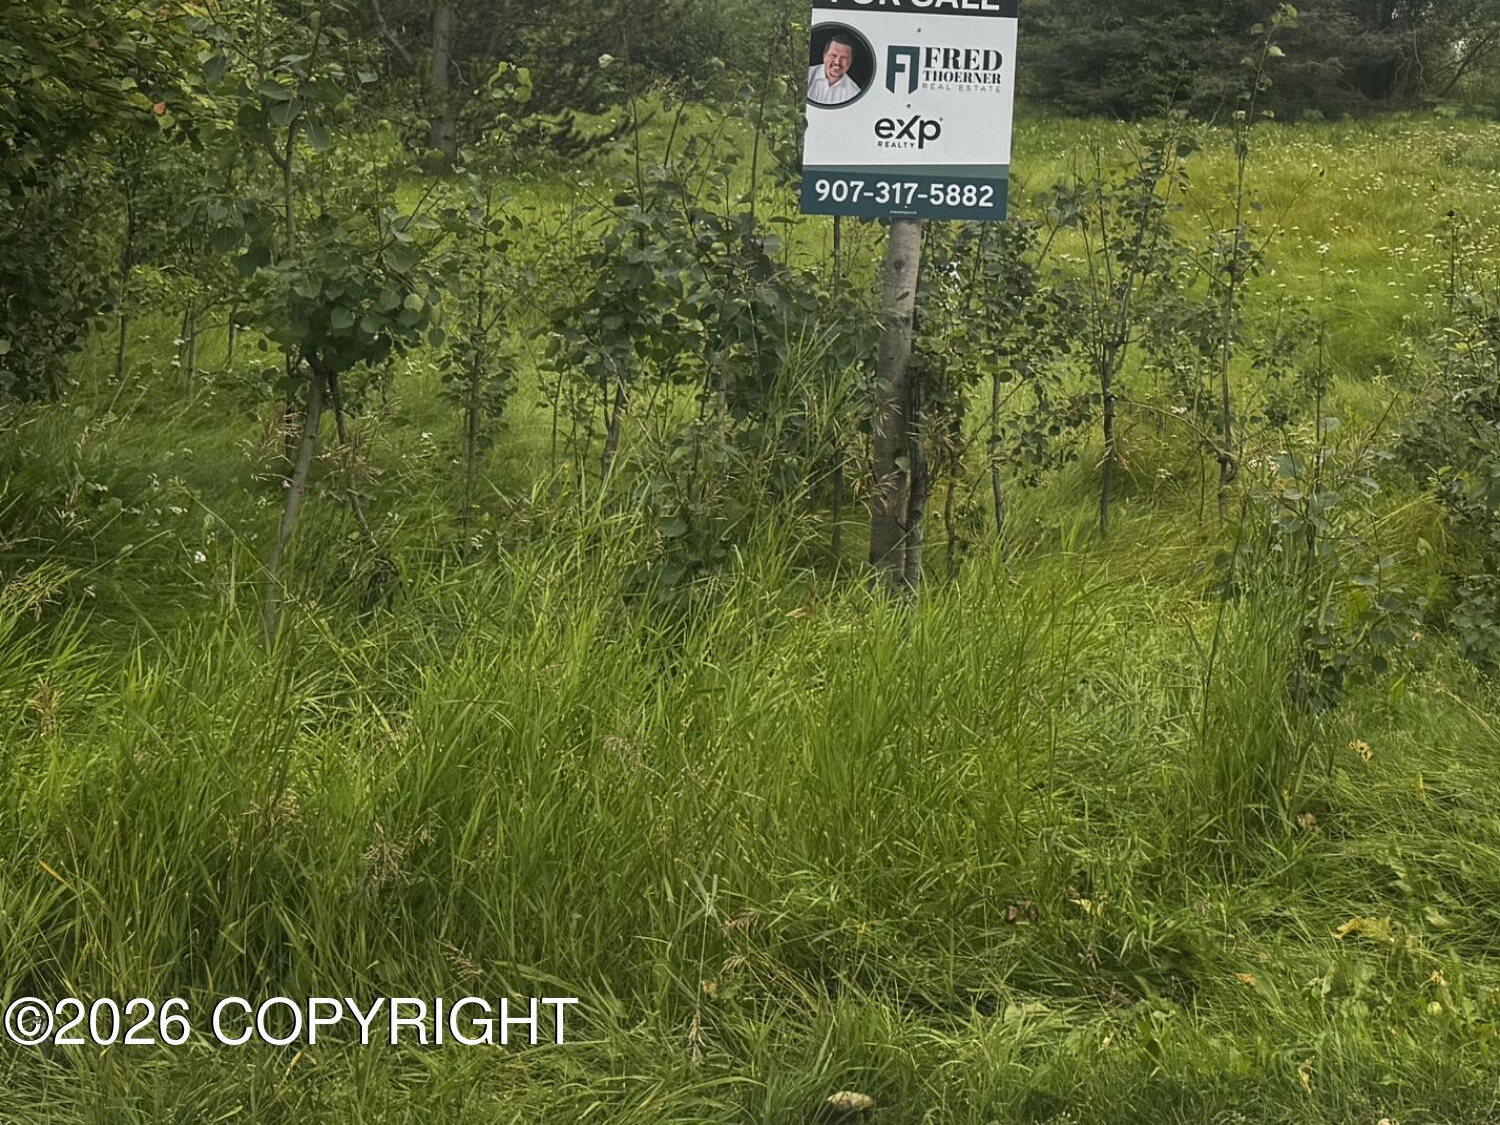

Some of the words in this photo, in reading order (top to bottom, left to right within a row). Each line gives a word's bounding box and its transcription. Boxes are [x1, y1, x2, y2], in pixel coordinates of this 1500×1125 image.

[924, 47, 1003, 71] FRED
[922, 70, 1001, 85] THOERNER
[922, 83, 951, 91] REAL
[959, 83, 1001, 93] ESTATE
[815, 179, 994, 207] 907-317-5882
